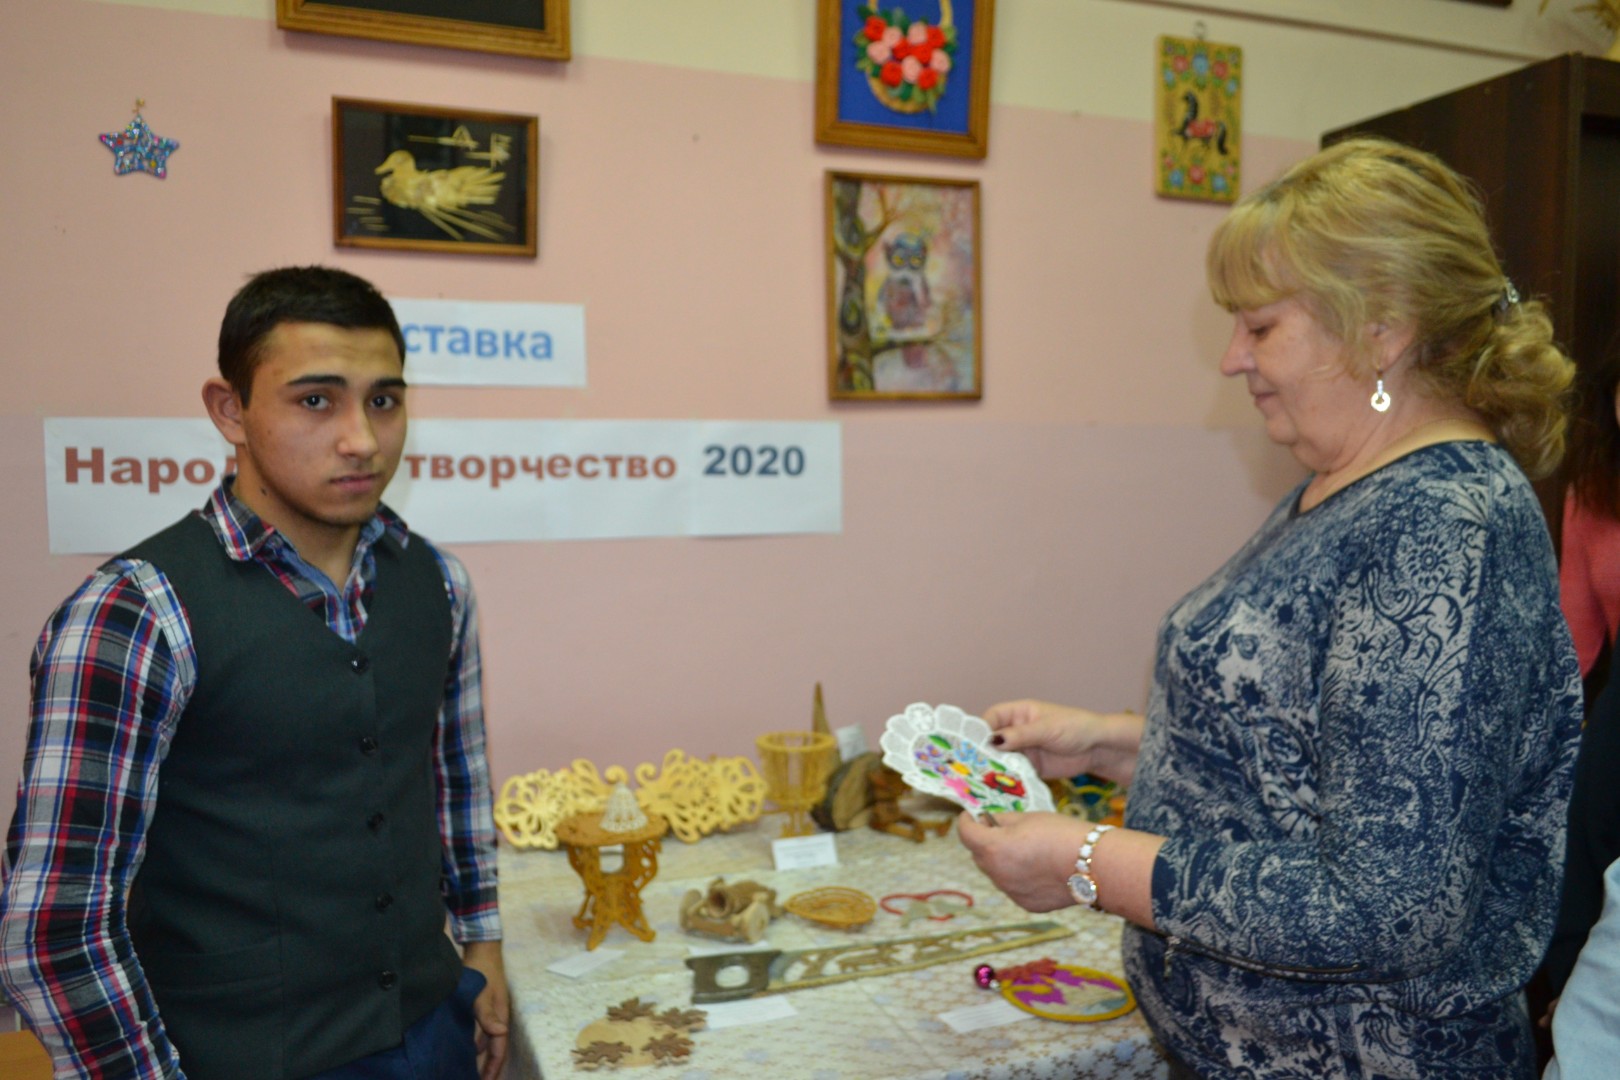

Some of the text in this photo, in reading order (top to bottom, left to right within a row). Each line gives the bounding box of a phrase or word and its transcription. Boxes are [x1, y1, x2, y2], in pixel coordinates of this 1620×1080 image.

[401, 323, 554, 360] ставка
[404, 453, 677, 488] творчество
[703, 444, 807, 477] 2020
